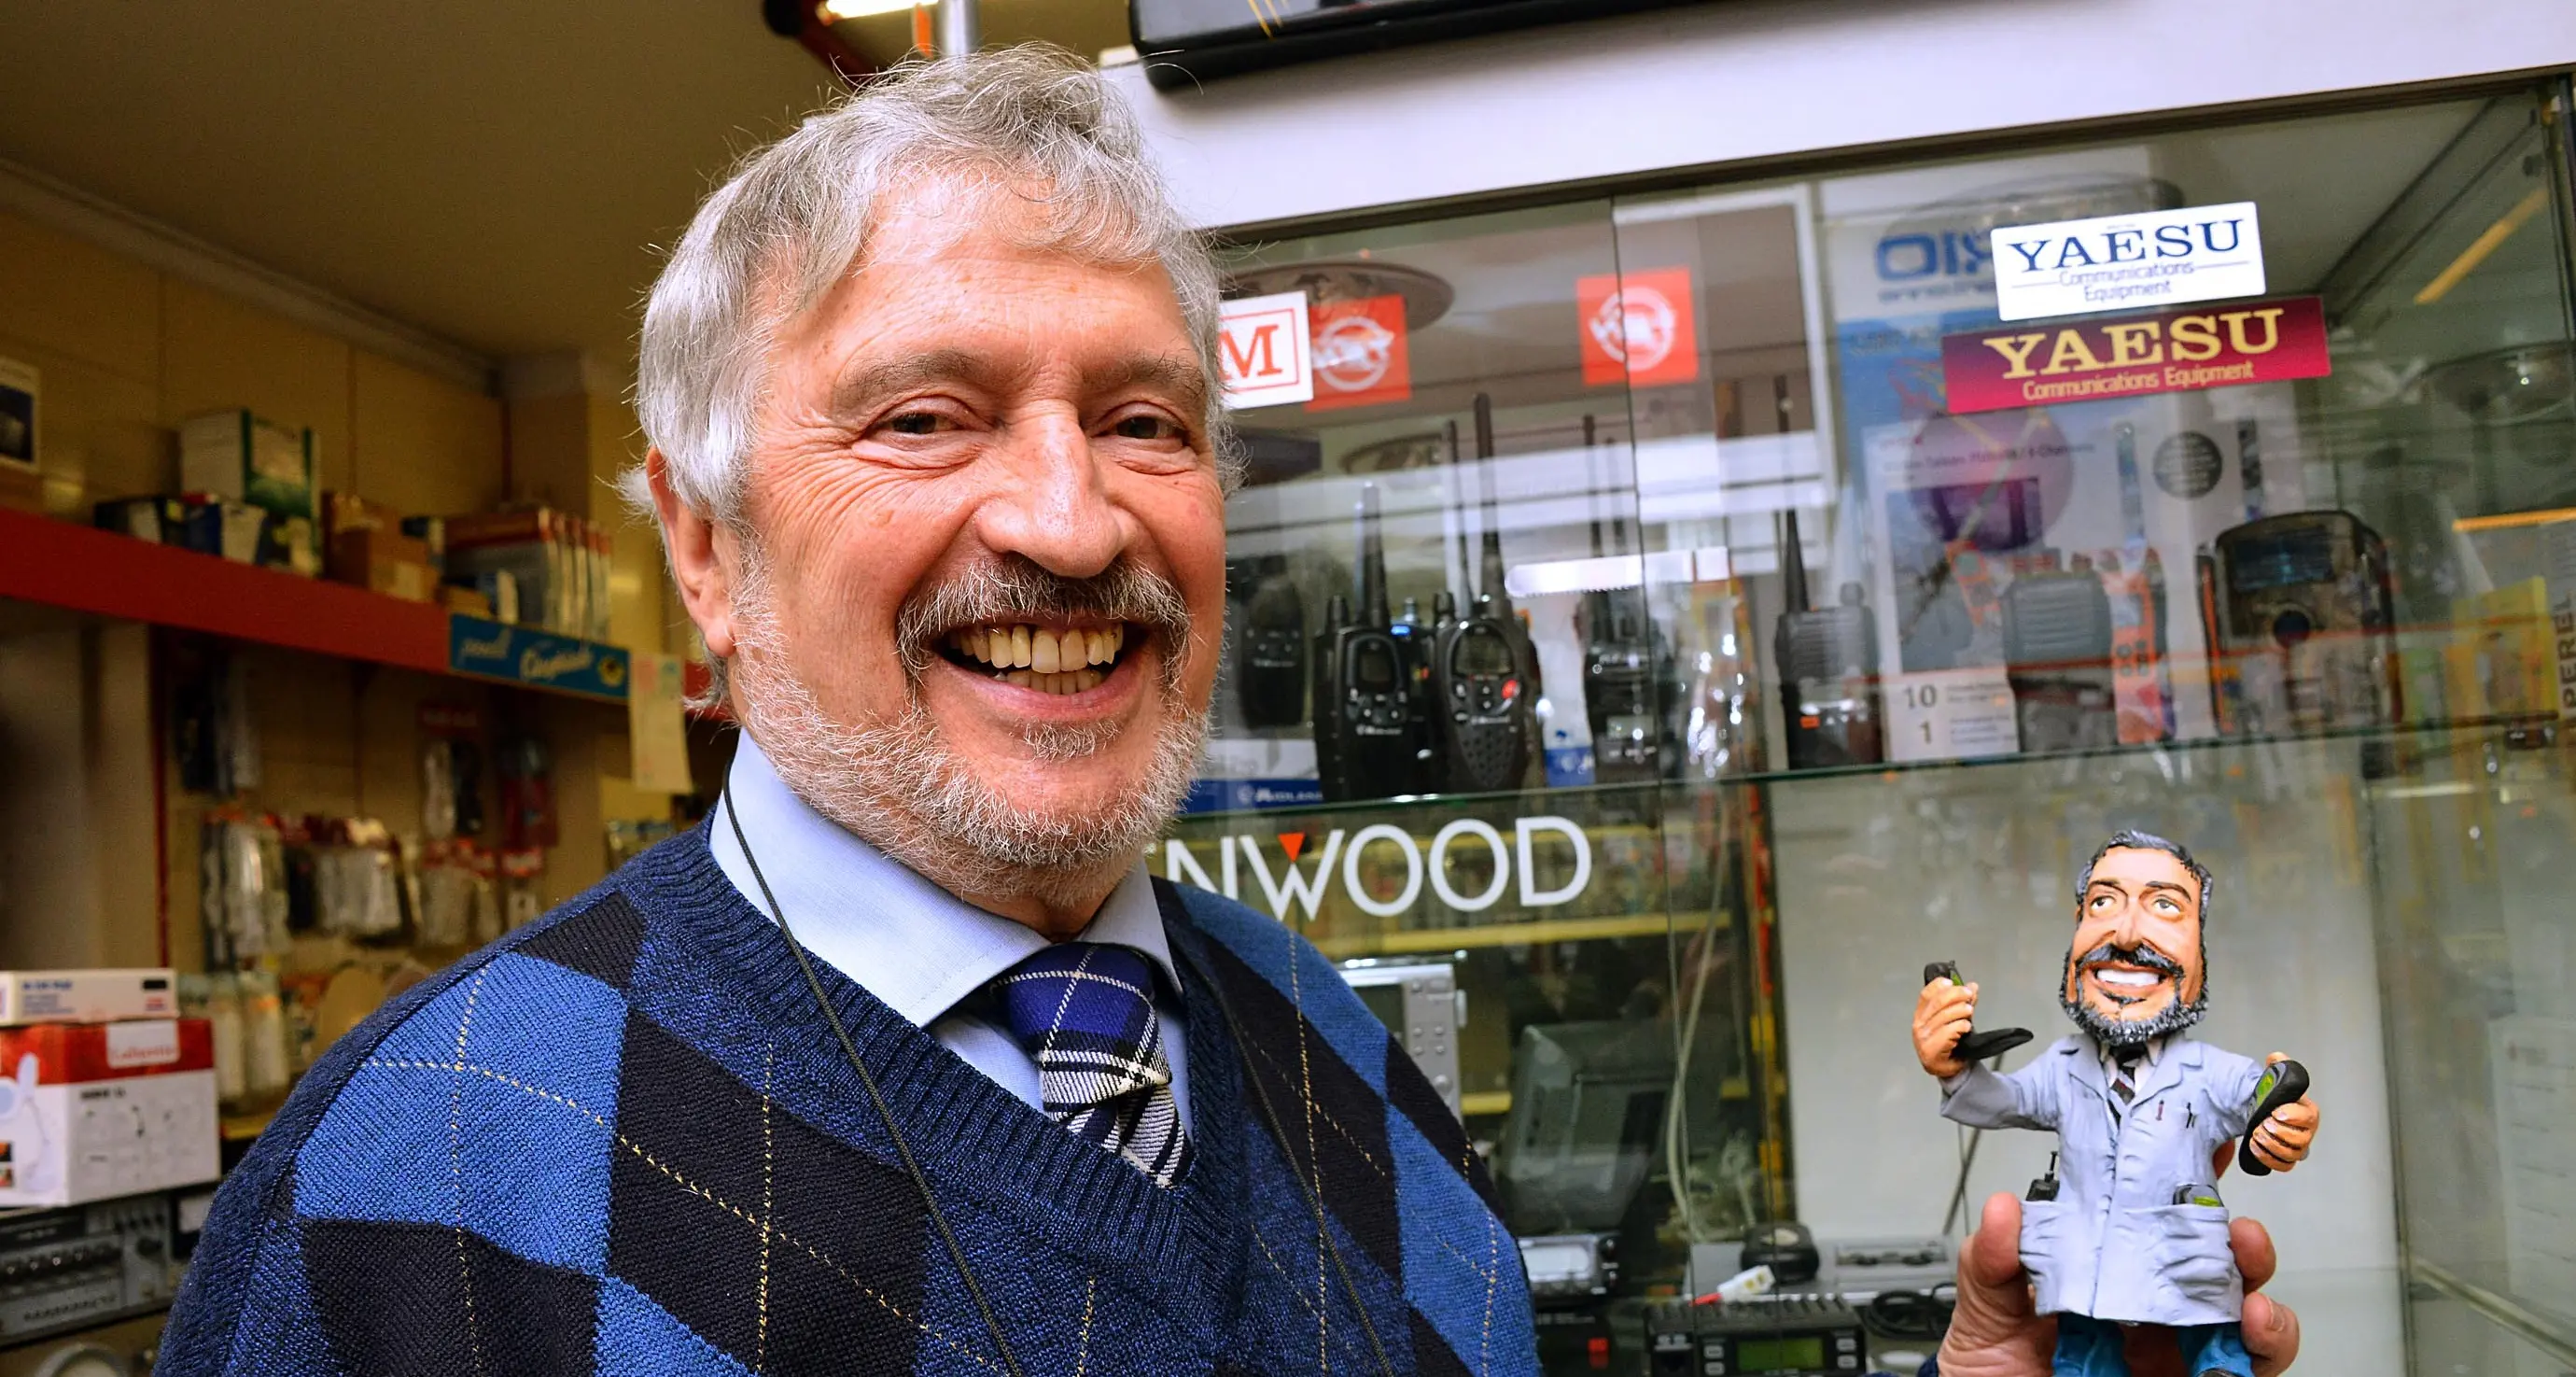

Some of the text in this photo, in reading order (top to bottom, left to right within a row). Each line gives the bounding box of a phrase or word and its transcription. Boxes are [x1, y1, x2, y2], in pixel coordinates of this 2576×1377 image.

[2007, 218, 2244, 273] YAESU
[2059, 260, 2195, 287] Communications
[2084, 280, 2172, 302] Equipment
[1982, 308, 2285, 379] YAESU
[2023, 360, 2255, 401] Communications Equipment
